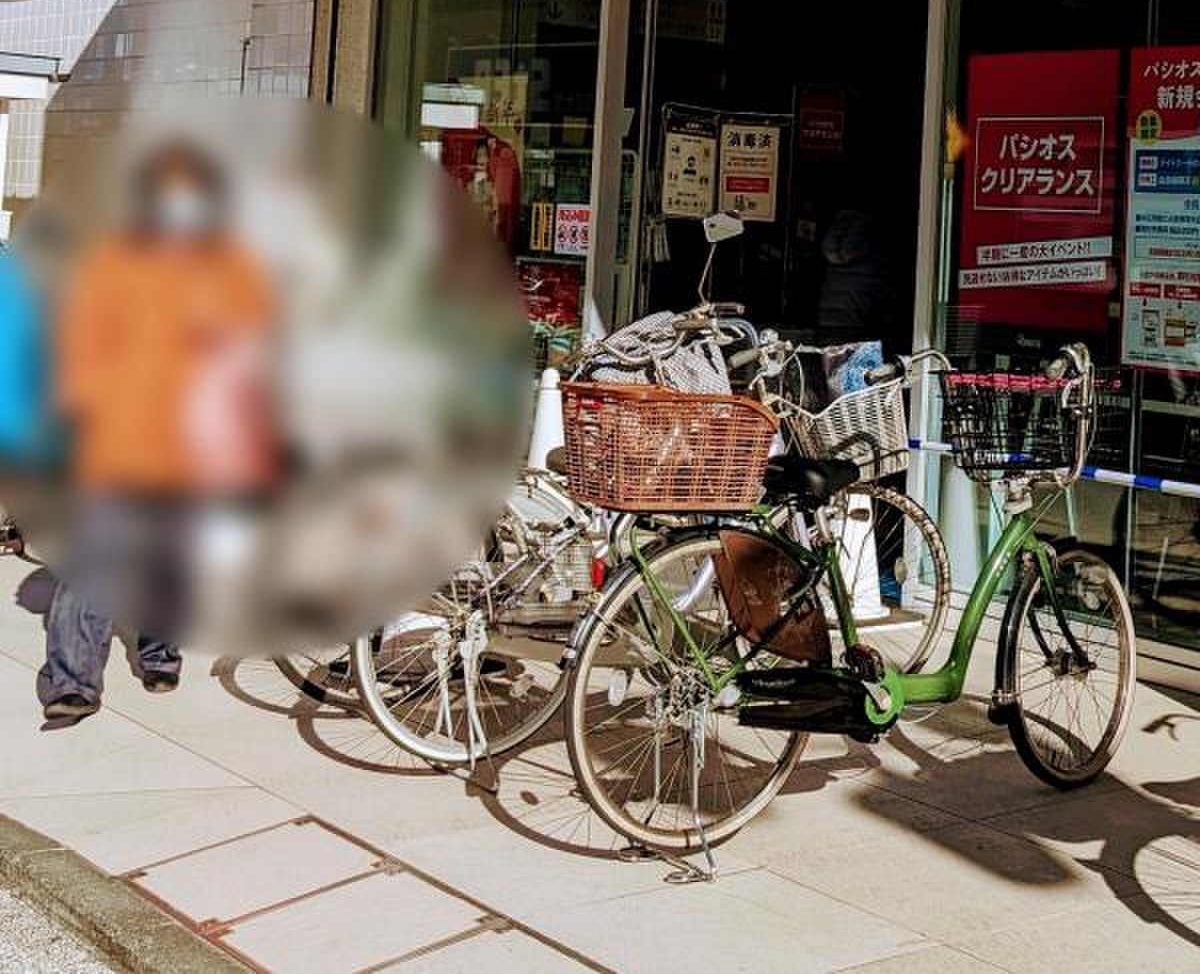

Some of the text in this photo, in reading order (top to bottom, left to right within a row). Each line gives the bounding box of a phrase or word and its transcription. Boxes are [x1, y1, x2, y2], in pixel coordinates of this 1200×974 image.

[998, 132, 1077, 161] パシオス
[980, 166, 1095, 195] クリアランス
